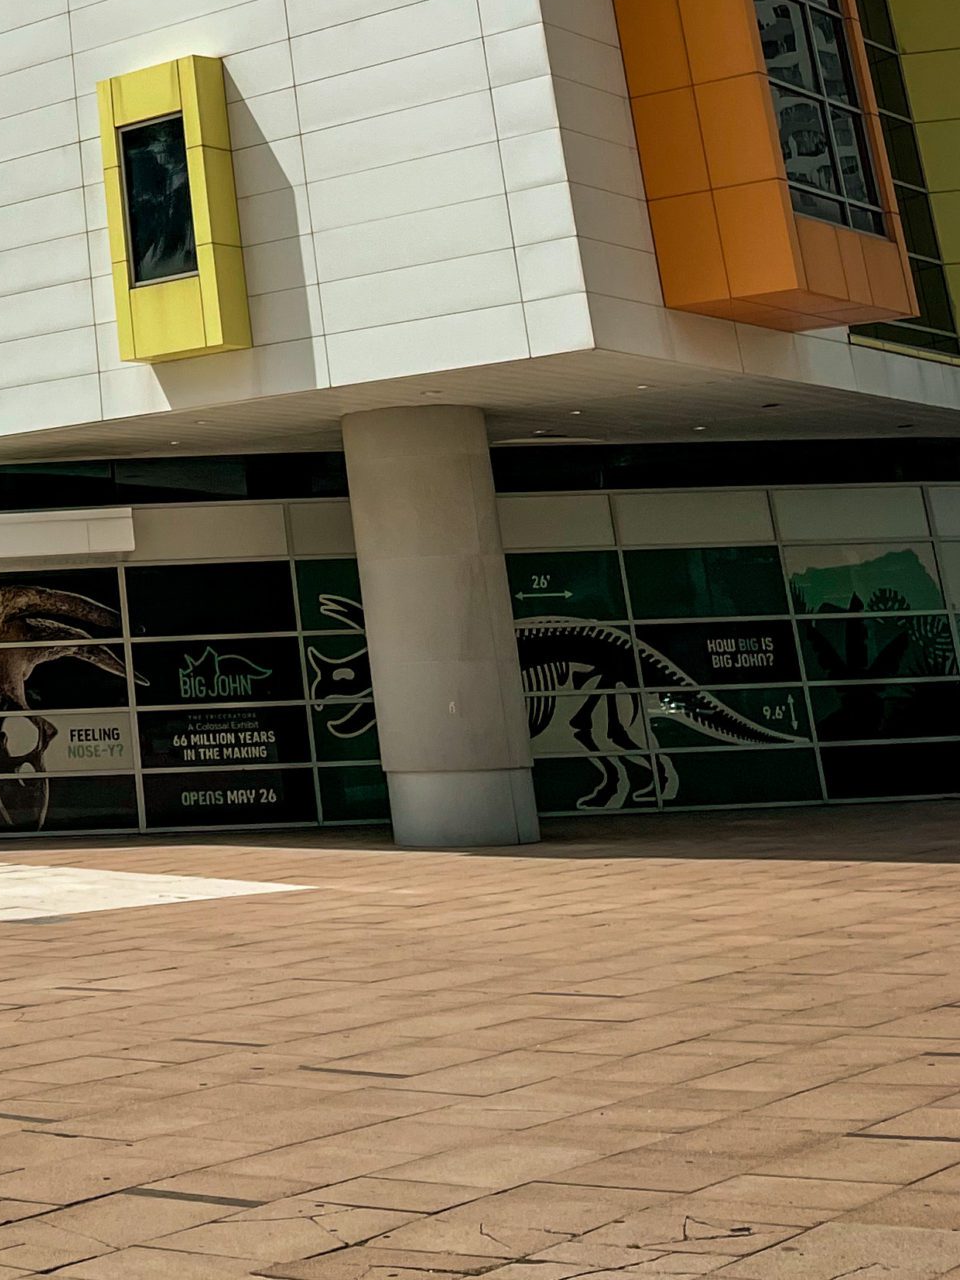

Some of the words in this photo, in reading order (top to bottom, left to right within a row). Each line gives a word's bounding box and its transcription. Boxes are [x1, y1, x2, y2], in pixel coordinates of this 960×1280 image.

[707, 639, 735, 652] HOW
[739, 638, 758, 651] BIG
[761, 637, 774, 651] IS
[712, 655, 732, 668] BIG
[208, 673, 252, 697] JOHN
[70, 727, 120, 742] FEELING
[173, 735, 187, 746] 66
[190, 732, 235, 746] MILLION
[238, 731, 276, 744] YEARS
[68, 743, 124, 759] NOSE-Y?
[184, 749, 195, 761] IN
[198, 748, 220, 760] THE
[223, 746, 268, 759] MAKING
[227, 790, 256, 804] MAY
[259, 789, 277, 803] 26
